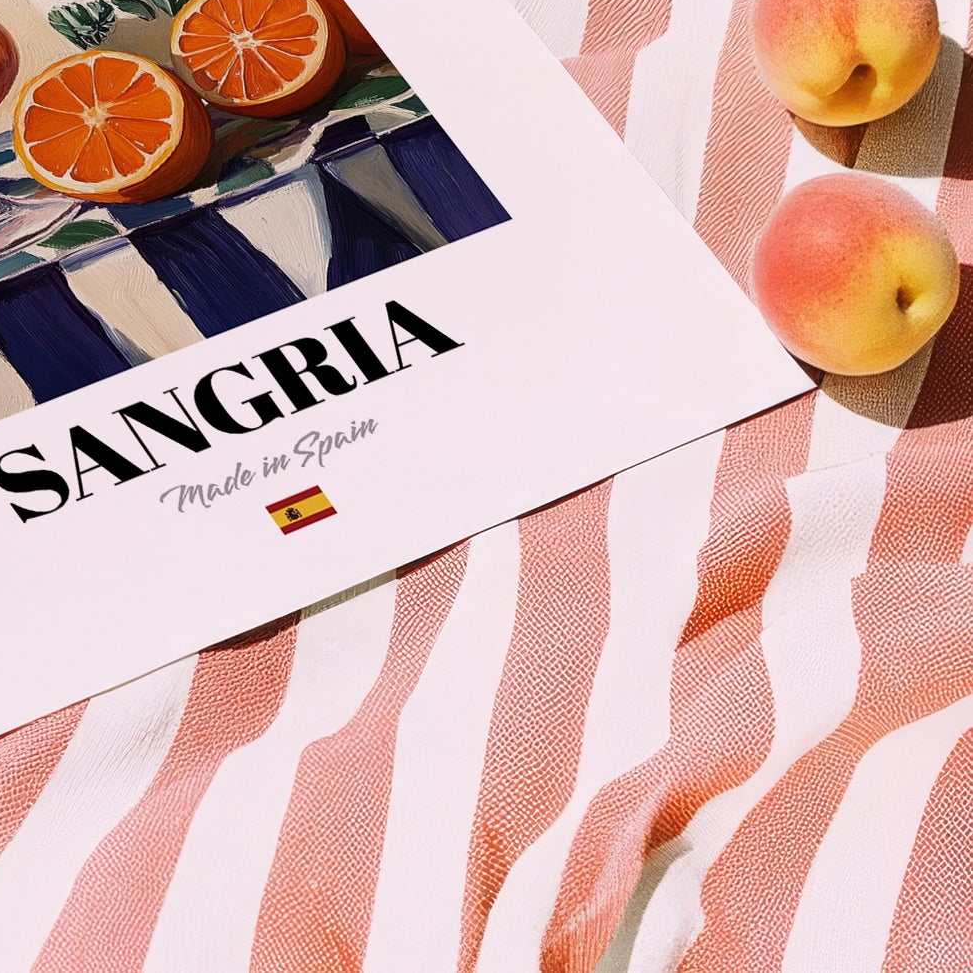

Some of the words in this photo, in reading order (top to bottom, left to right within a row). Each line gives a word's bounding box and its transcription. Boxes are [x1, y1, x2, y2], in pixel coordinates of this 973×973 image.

[159, 462, 256, 513] Made
[263, 454, 290, 478] in
[293, 418, 378, 467] Spain
